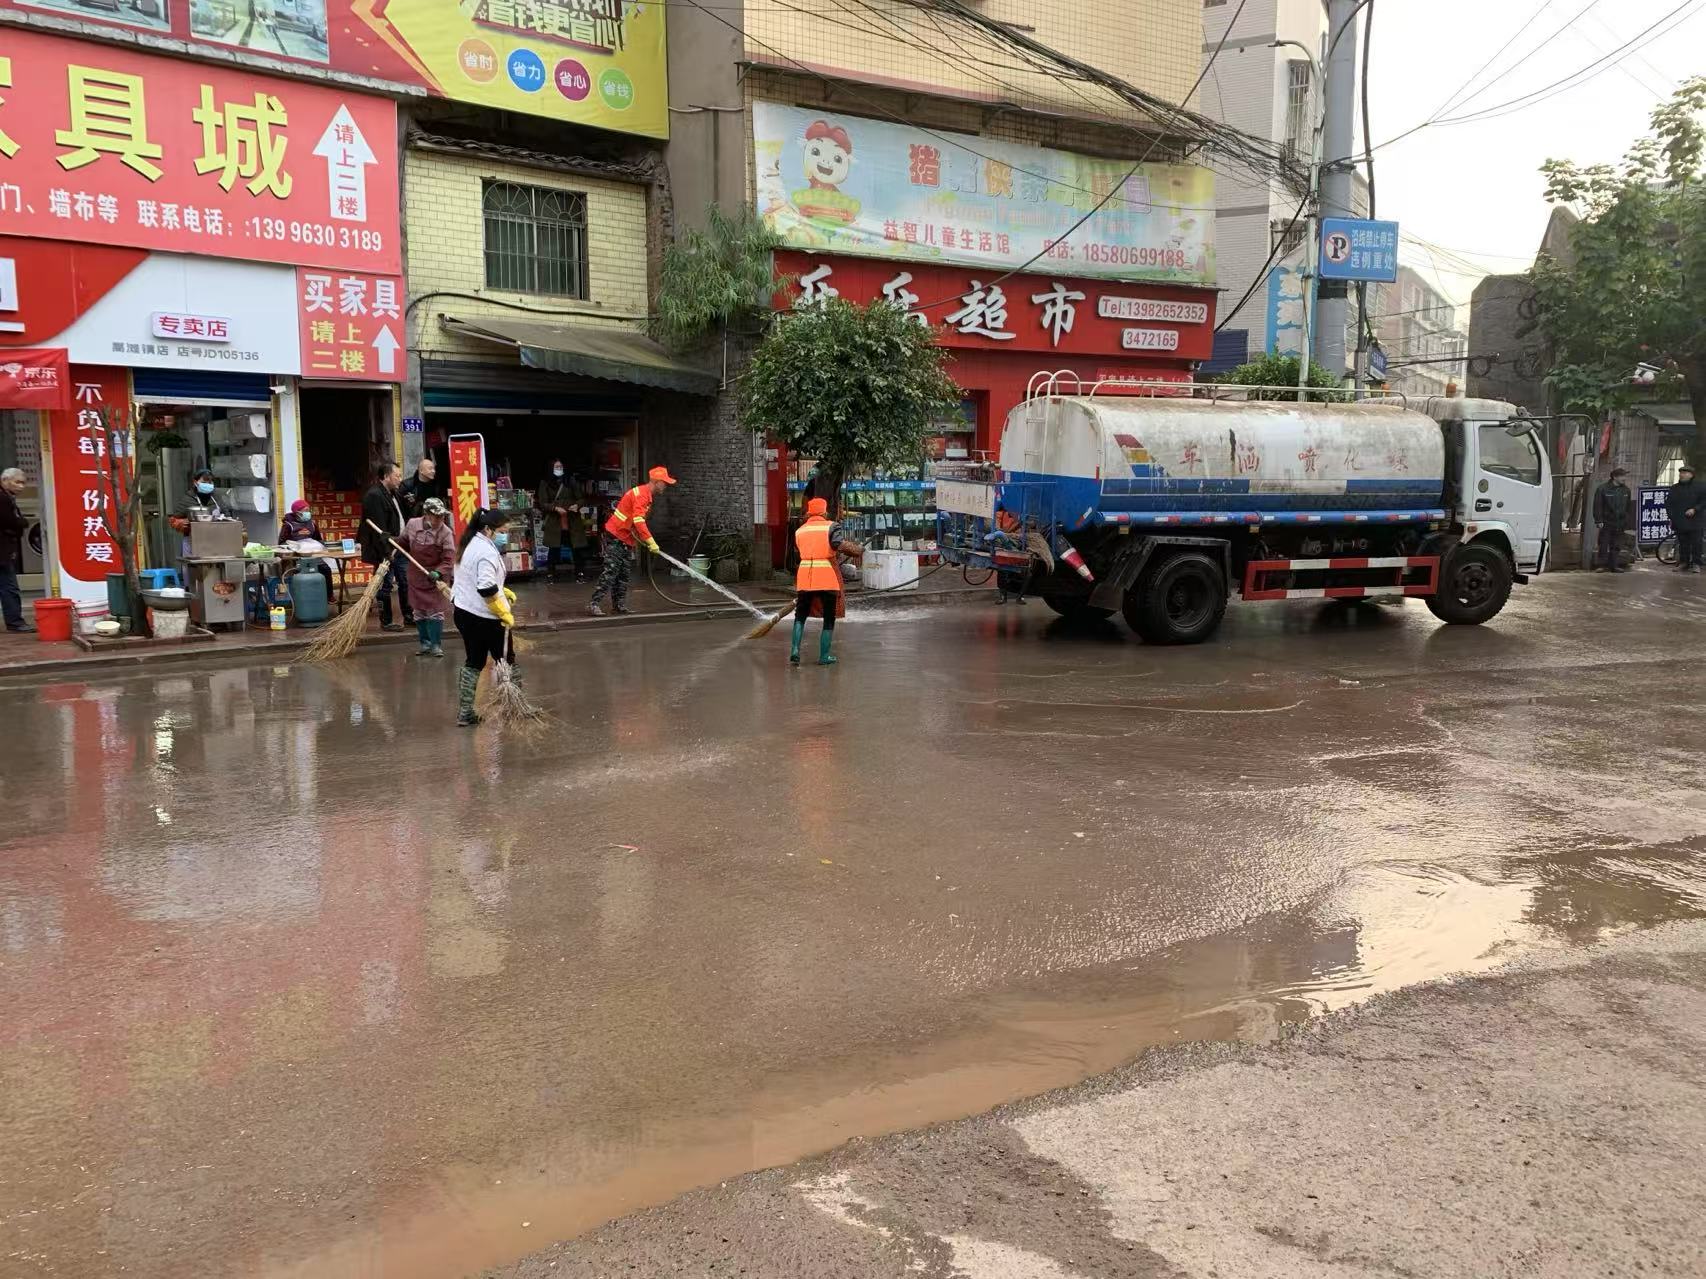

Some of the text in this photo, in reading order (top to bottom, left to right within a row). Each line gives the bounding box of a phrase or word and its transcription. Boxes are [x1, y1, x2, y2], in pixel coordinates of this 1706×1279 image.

[463, 52, 493, 71] 省时
[512, 60, 541, 81] 省力
[559, 70, 587, 89] 省心
[0, 56, 293, 200] 具城
[333, 122, 360, 217] 请上二楼
[289, 221, 335, 247] 9630
[339, 226, 383, 252] 3189
[883, 218, 1011, 255] 益智儿童生活馆
[304, 274, 401, 320] 买家具
[159, 316, 227, 338] 专卖店
[309, 320, 365, 345] 请上
[1126, 331, 1178, 348] 3472165
[311, 349, 366, 373] 二楼
[404, 423, 421, 431] 391
